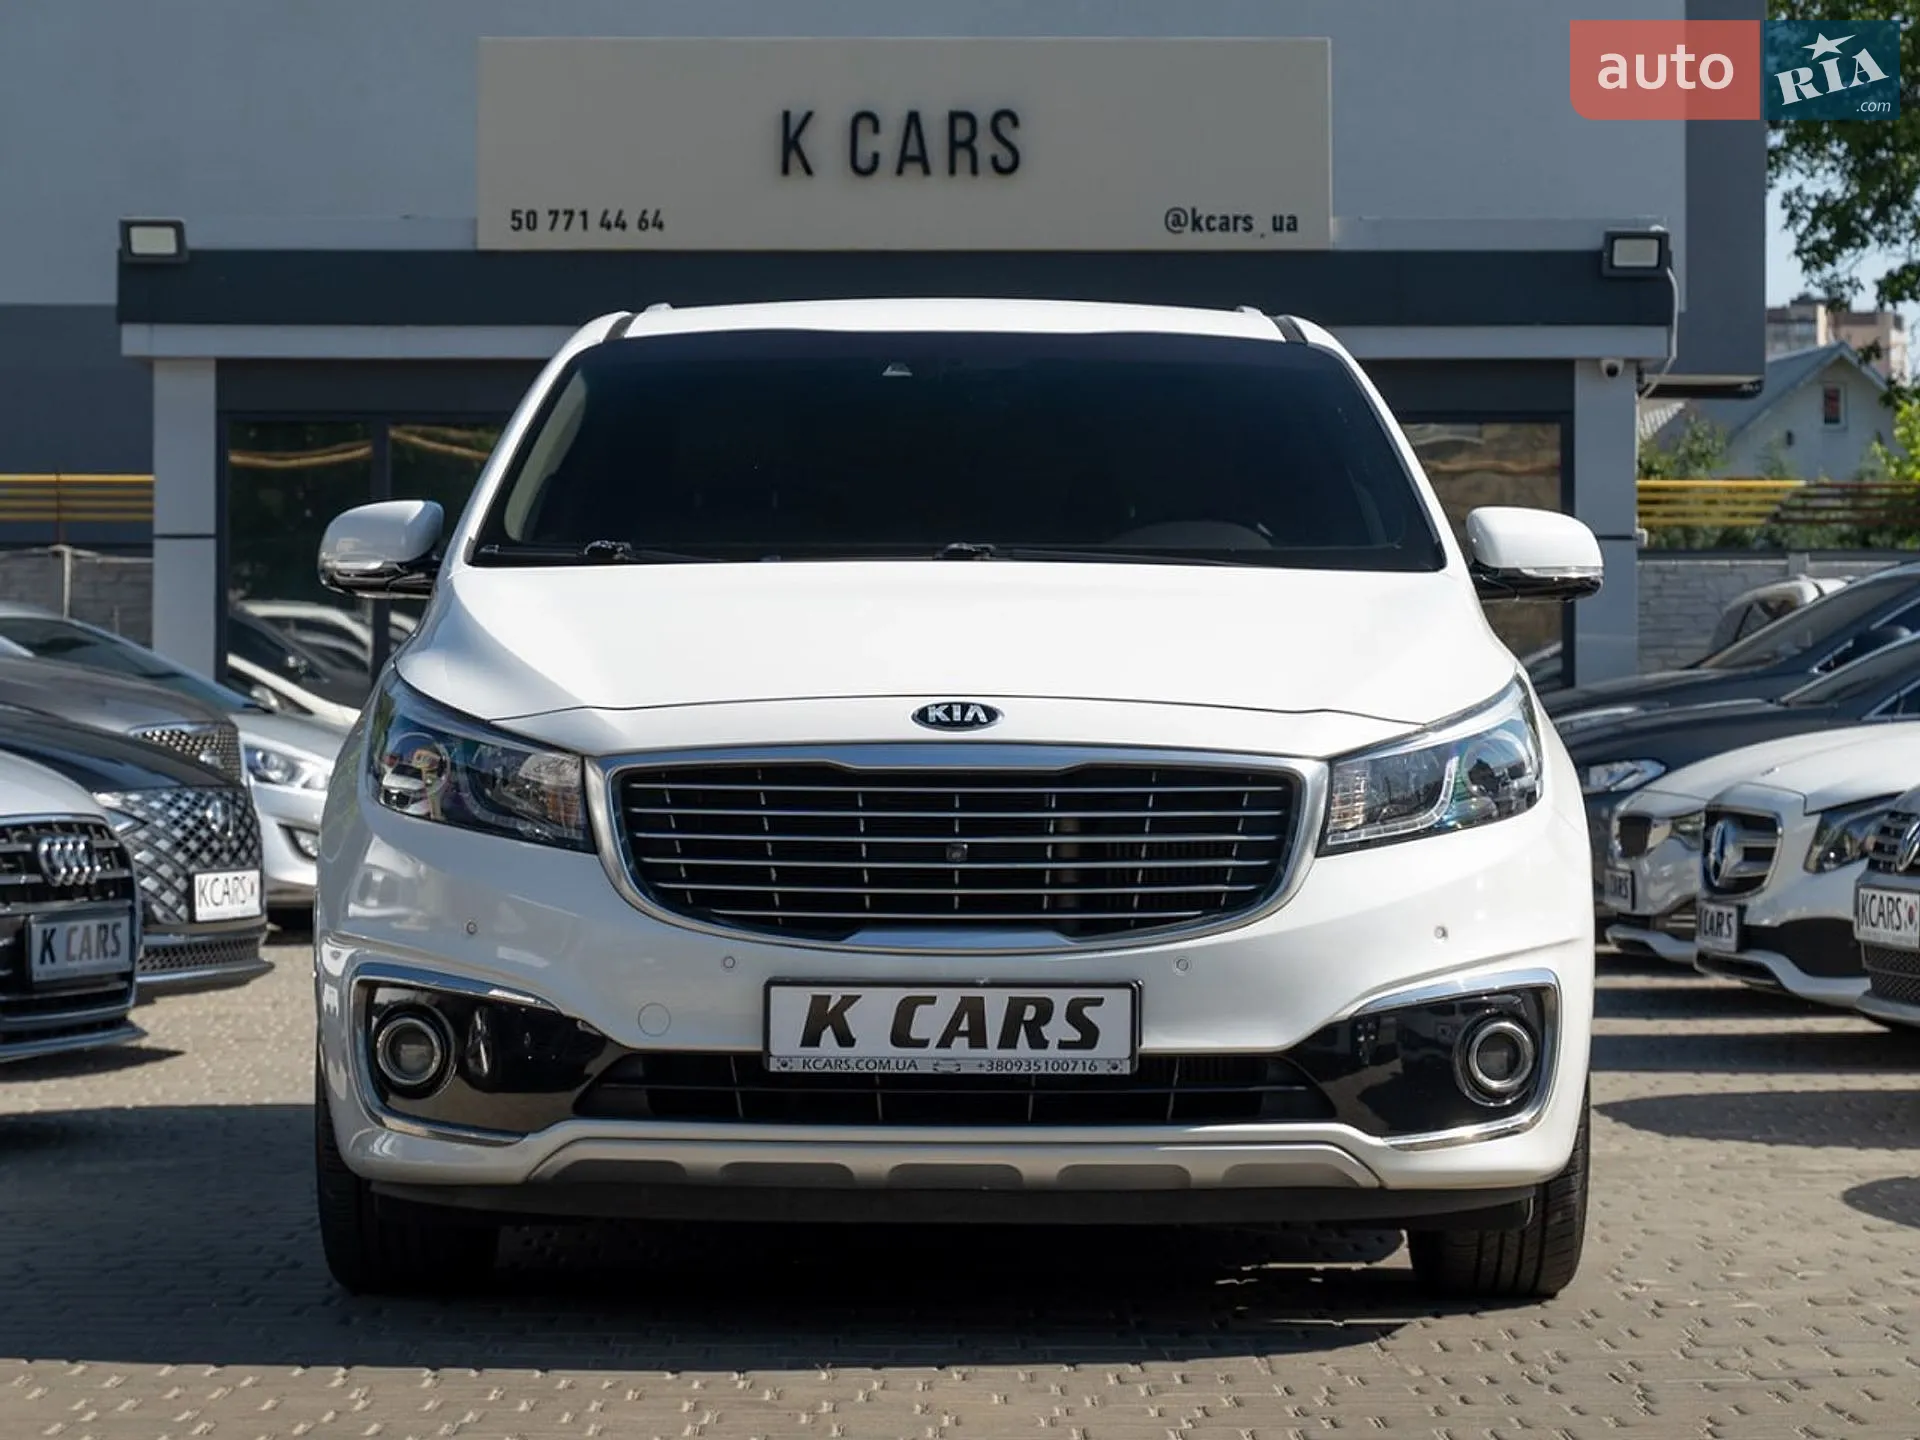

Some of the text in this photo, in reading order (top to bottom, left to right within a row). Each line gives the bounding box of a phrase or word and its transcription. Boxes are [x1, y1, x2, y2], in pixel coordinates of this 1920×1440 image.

[780, 108, 1022, 177] K CARS
[510, 208, 664, 232] 50 771 44 64
[926, 703, 989, 723] KIA
[1861, 893, 1902, 931] KCARS
[39, 922, 122, 966] K CARS
[800, 994, 1105, 1050] K CARS
[802, 1058, 1098, 1074] KCARS.COM.UA +380935100716
